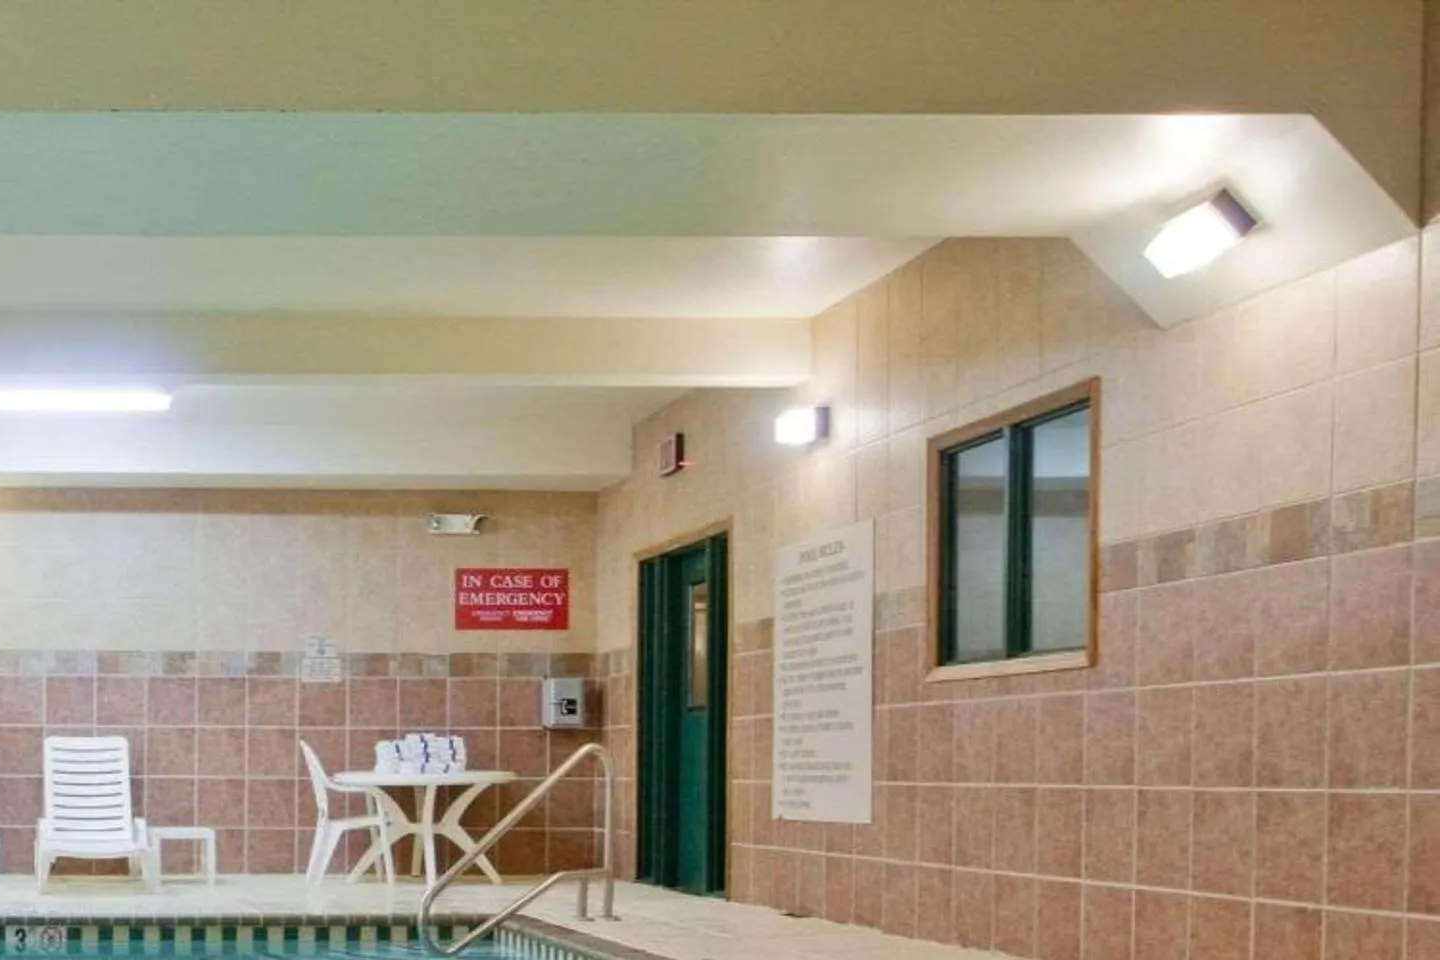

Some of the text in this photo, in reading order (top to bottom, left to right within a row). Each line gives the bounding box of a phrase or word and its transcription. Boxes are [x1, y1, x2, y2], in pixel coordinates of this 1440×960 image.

[461, 575, 563, 588] IN CASE OF
[458, 592, 566, 606] EMERGENCY
[14, 928, 27, 953] 3
